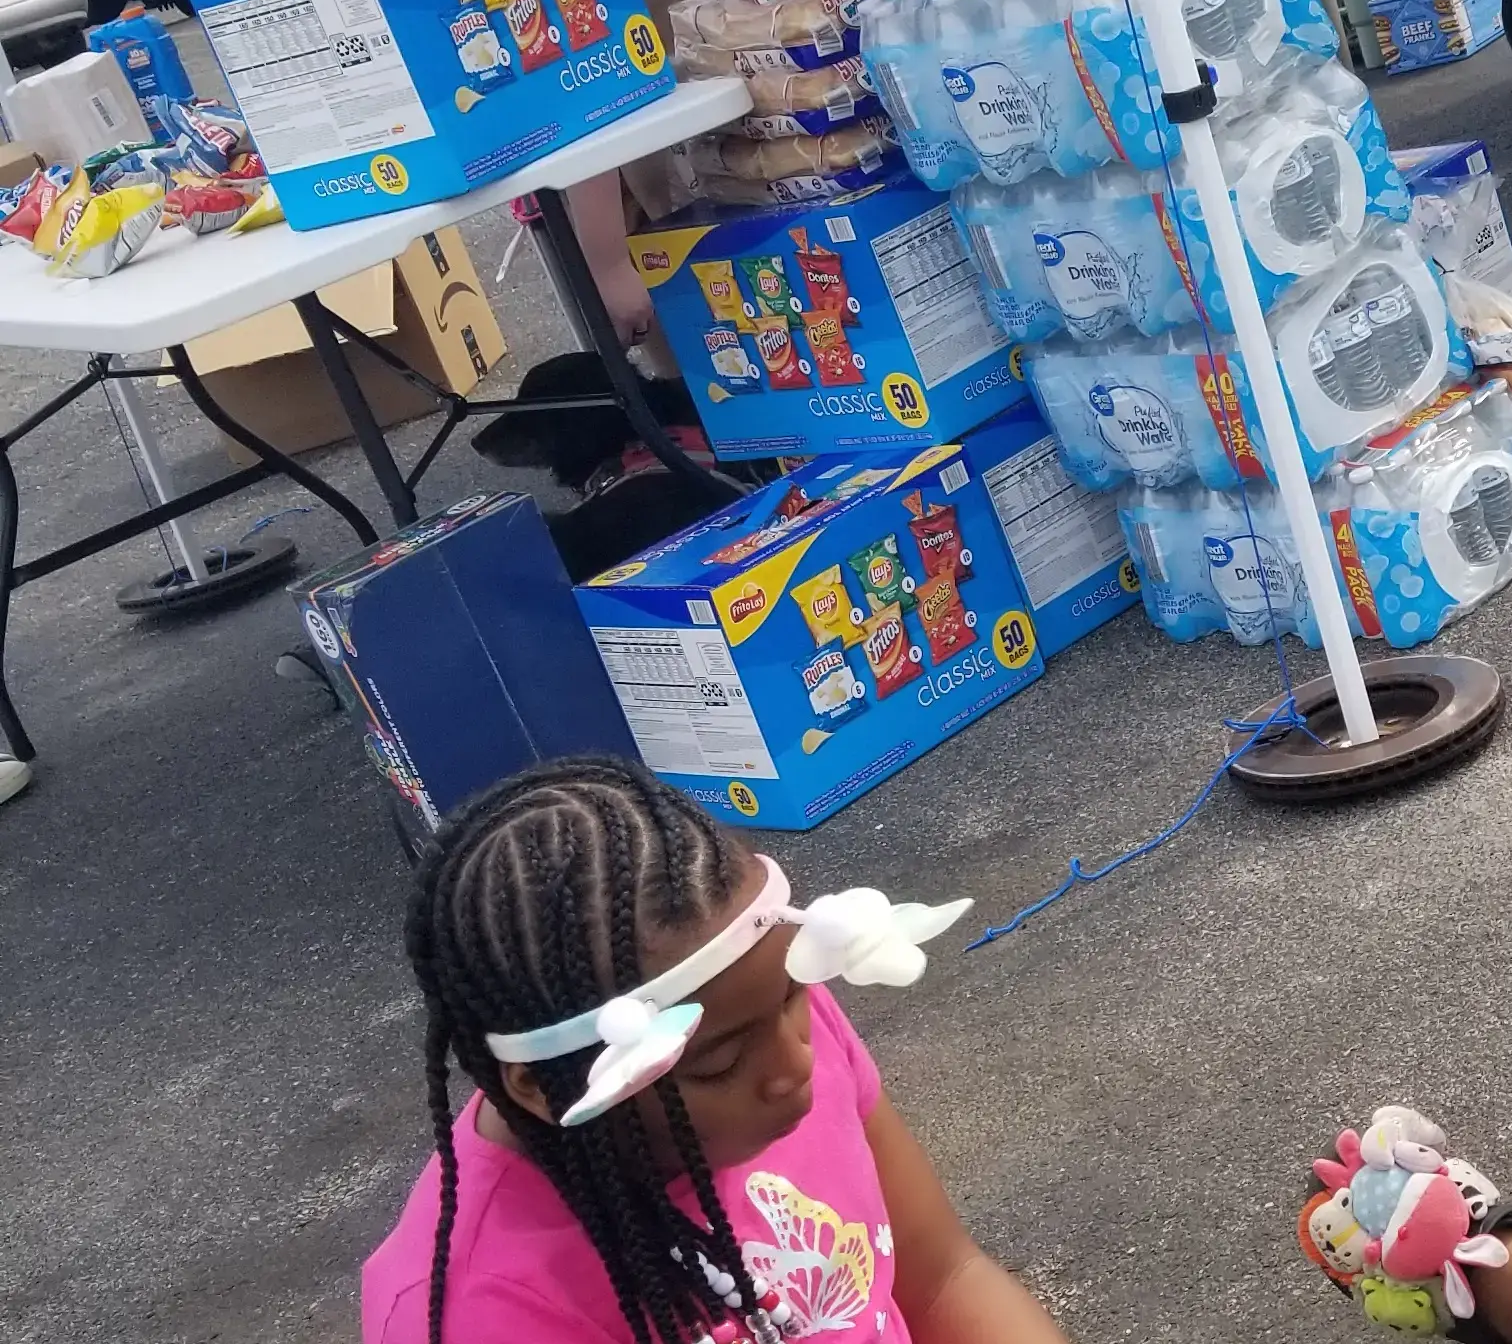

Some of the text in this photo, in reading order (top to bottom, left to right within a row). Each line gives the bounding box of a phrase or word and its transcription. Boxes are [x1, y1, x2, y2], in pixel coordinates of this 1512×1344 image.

[451, 11, 488, 44] RUFFLES
[1401, 20, 1433, 37] BEEF
[1403, 32, 1436, 46] FRANKS
[629, 24, 655, 58] 50
[560, 42, 627, 91] classic
[615, 65, 632, 80] MIX
[641, 53, 660, 69] BAGS
[376, 160, 399, 182] 50
[313, 171, 373, 197] classic
[709, 281, 731, 297] Lay's
[759, 276, 780, 293] Lay's
[807, 270, 840, 285] Doritos
[759, 328, 788, 360] Fritos
[963, 364, 1010, 401] classic
[1203, 372, 1235, 394] 40
[808, 387, 883, 417] classic
[889, 383, 918, 410] 50
[870, 412, 888, 422] MIX
[901, 410, 923, 420] BAGS
[921, 529, 954, 550] Doritos
[870, 560, 892, 584] Lay's
[814, 591, 837, 614] Lay's
[923, 582, 952, 622] Cheetos
[1071, 579, 1119, 618] classic
[868, 618, 900, 665] Fritos
[999, 619, 1024, 654] 50
[1008, 644, 1029, 664] BAGS
[804, 651, 843, 687] RUFFLES
[917, 646, 993, 707] classic
[980, 663, 997, 682] MIX
[732, 787, 752, 805] 50
